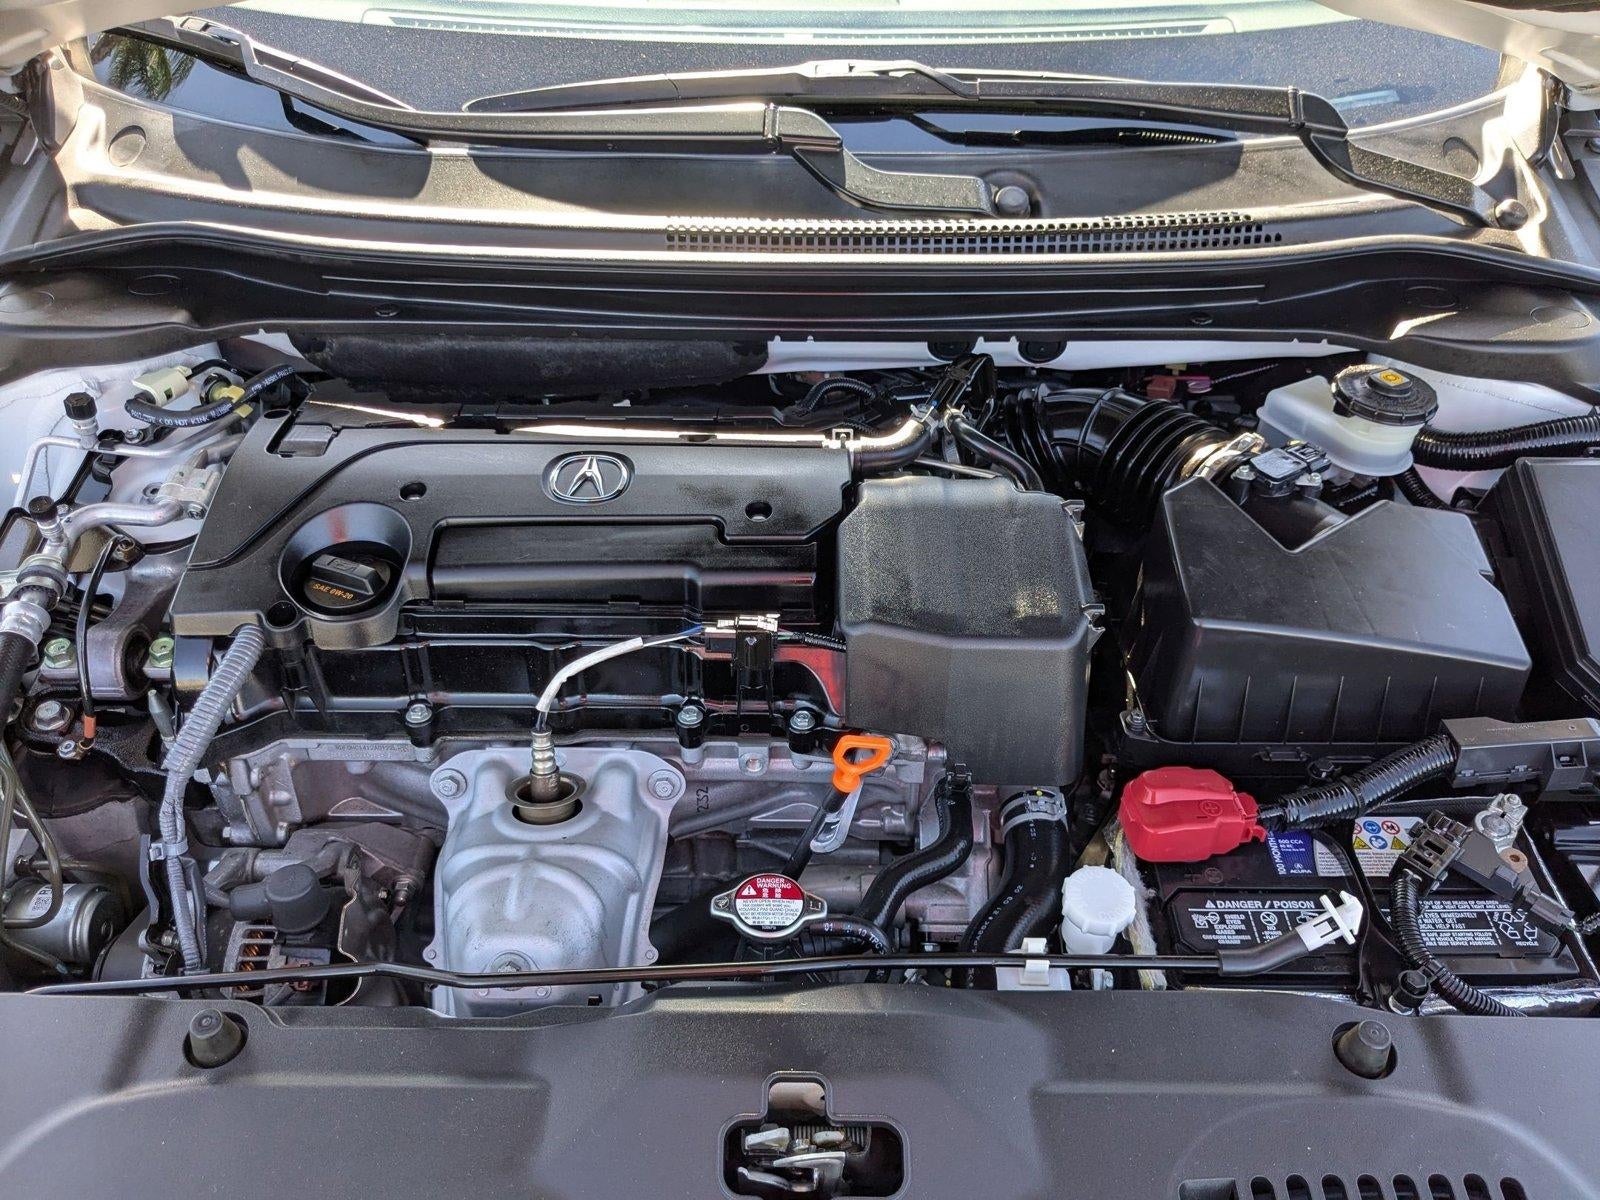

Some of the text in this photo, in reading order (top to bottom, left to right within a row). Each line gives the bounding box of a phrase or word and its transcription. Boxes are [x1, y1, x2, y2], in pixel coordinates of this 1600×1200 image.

[191, 415, 209, 424] KINK
[313, 583, 354, 600] SAE 0W-20
[1216, 900, 1315, 908] DANGER / POISON
